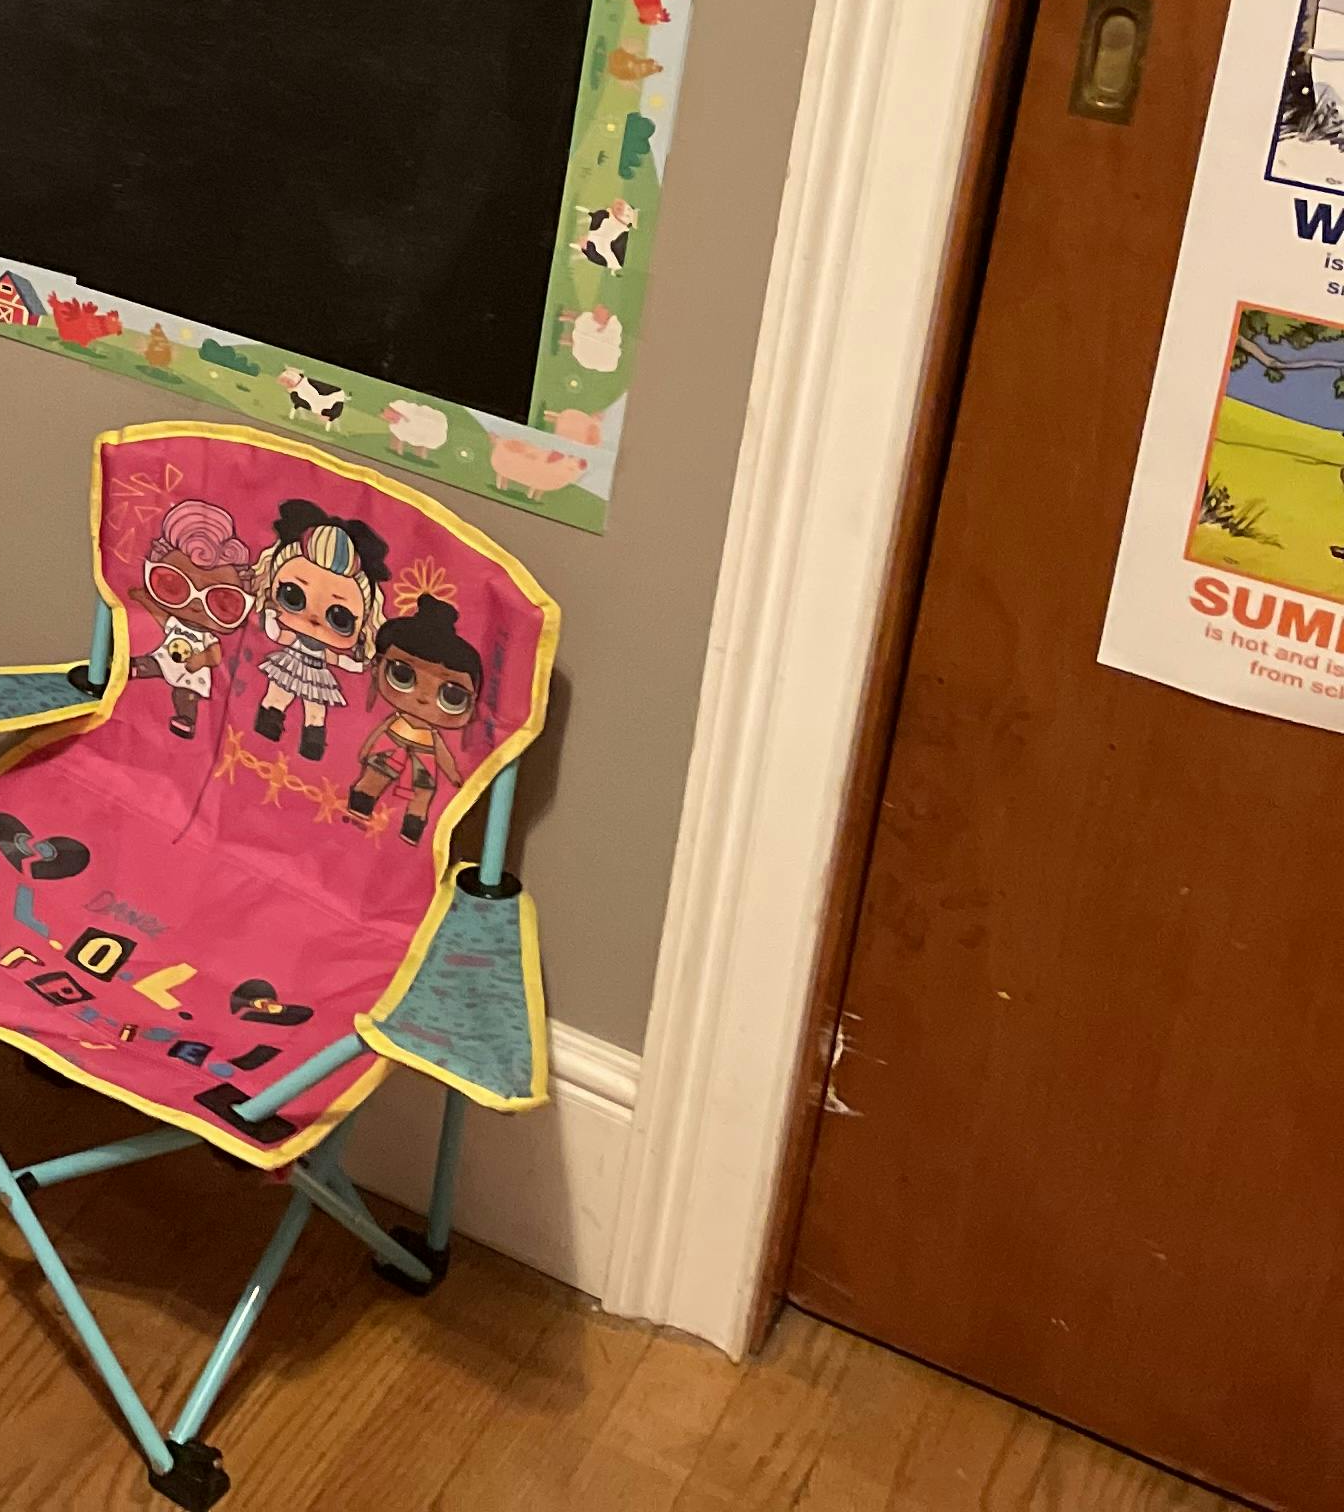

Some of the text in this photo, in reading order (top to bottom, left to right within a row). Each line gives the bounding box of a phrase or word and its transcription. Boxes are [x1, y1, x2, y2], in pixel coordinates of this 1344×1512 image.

[1188, 576, 1344, 654] SUM
[1205, 622, 1223, 641] is
[1231, 631, 1269, 656] hot
[1274, 647, 1320, 670] and
[1250, 660, 1304, 688] from
